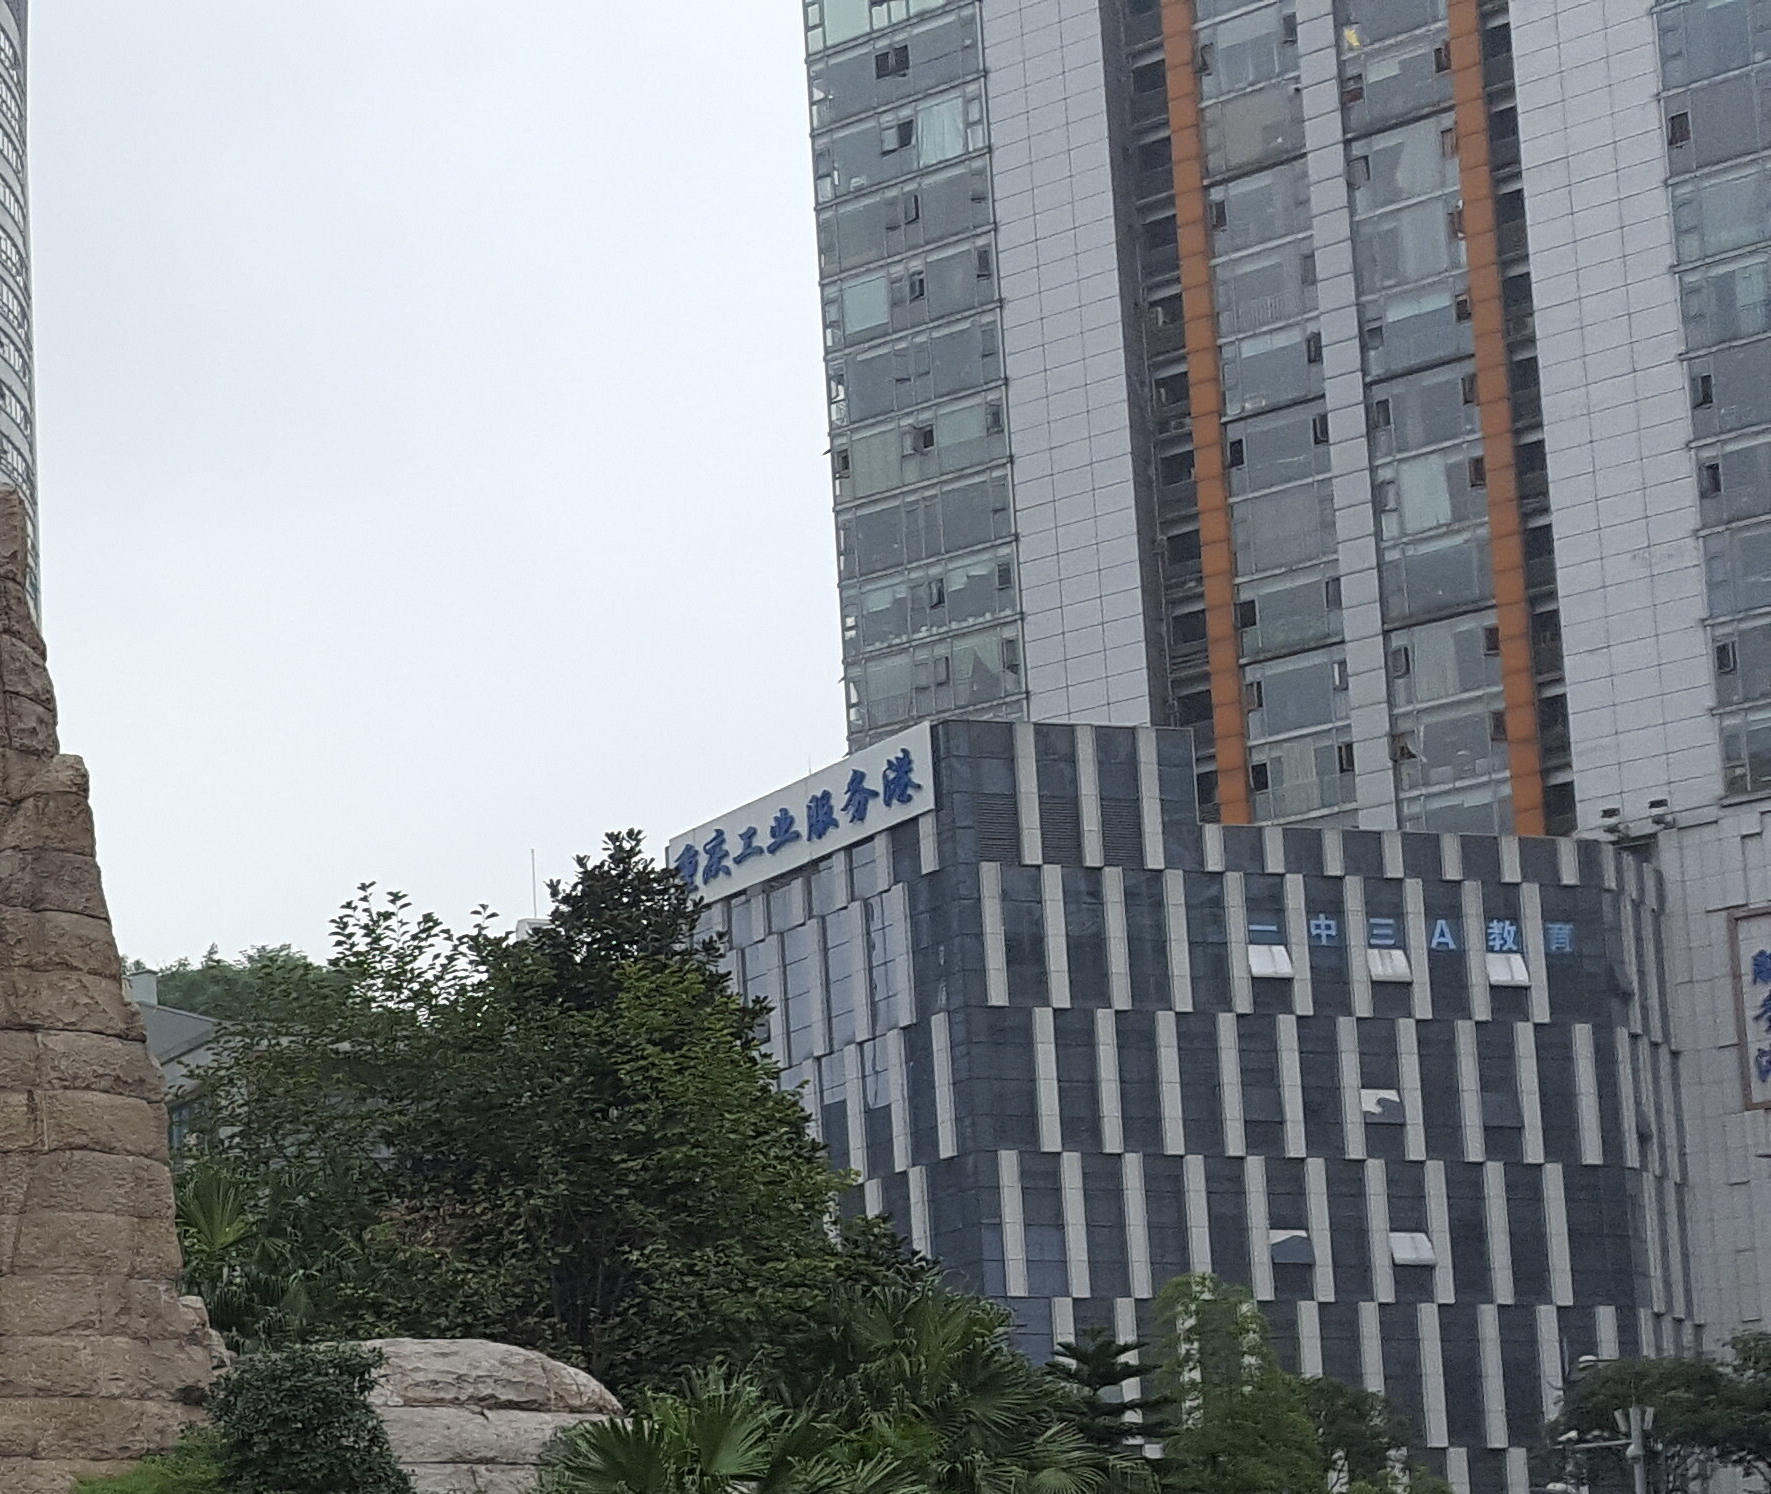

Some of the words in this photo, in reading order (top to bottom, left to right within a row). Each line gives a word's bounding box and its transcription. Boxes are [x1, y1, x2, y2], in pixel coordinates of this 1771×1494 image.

[674, 748, 922, 894] 重庆工业服务港
